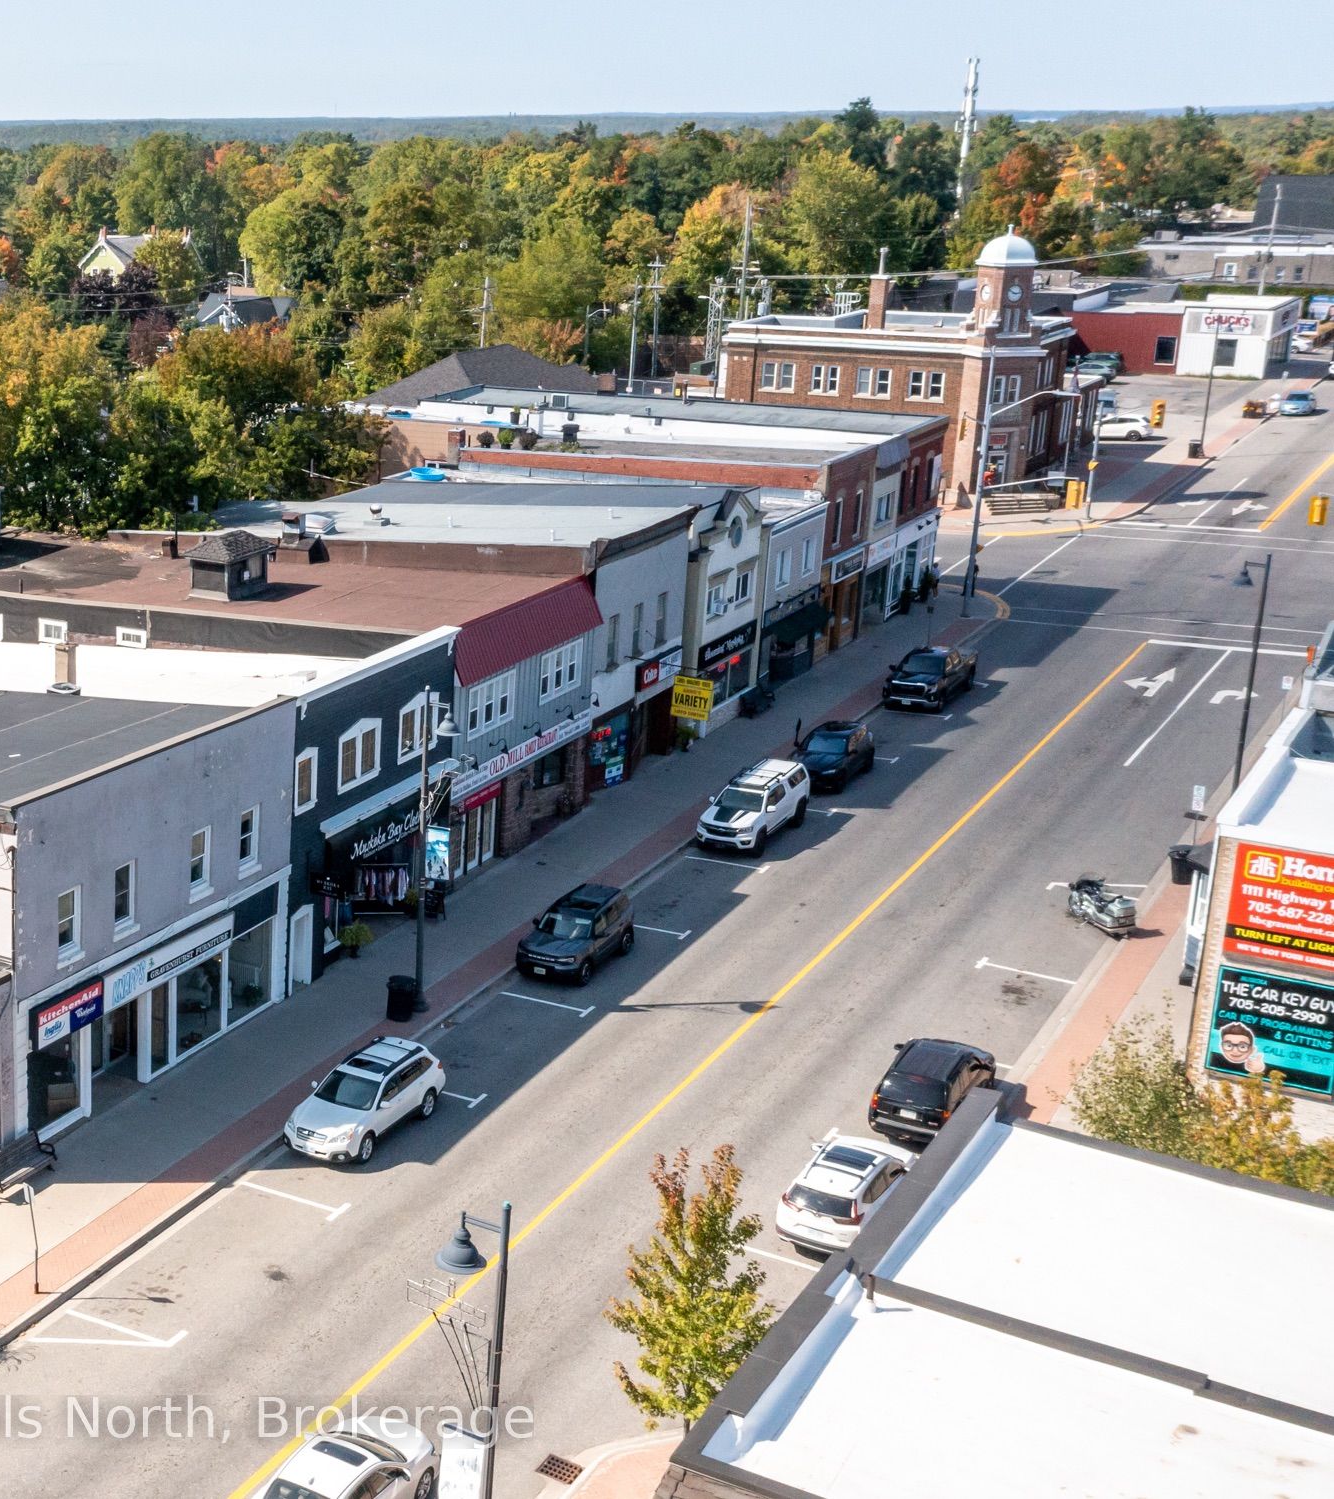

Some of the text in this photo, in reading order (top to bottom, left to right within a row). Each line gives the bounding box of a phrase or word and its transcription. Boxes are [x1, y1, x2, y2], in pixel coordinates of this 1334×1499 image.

[1204, 316, 1250, 327] CHUCK'S
[674, 692, 708, 709] VARIETY
[489, 755, 505, 776] OLD
[506, 747, 524, 767] MILL
[350, 826, 386, 860] Muskoka
[387, 821, 403, 842] Bay
[1281, 877, 1324, 893] building
[1266, 888, 1327, 910] Highway
[1247, 900, 1334, 925] 705-687-228
[1235, 927, 1265, 940] TURN
[1266, 933, 1292, 945] LEFT
[1292, 938, 1307, 948] AT
[149, 951, 194, 979] GRAVENHURST
[195, 932, 229, 956] FURNITURE
[1221, 980, 1250, 997] THE
[1251, 986, 1279, 1002] CAR
[1281, 991, 1309, 1007] KEY
[39, 987, 99, 1026] KitchenAid
[1228, 997, 1327, 1025] 705-205-2990
[1218, 1010, 1334, 1040] CAR KEY PROGRAMMING
[1274, 1031, 1333, 1050] & CUTTING
[1263, 1045, 1331, 1066] CALL OR TEXT
